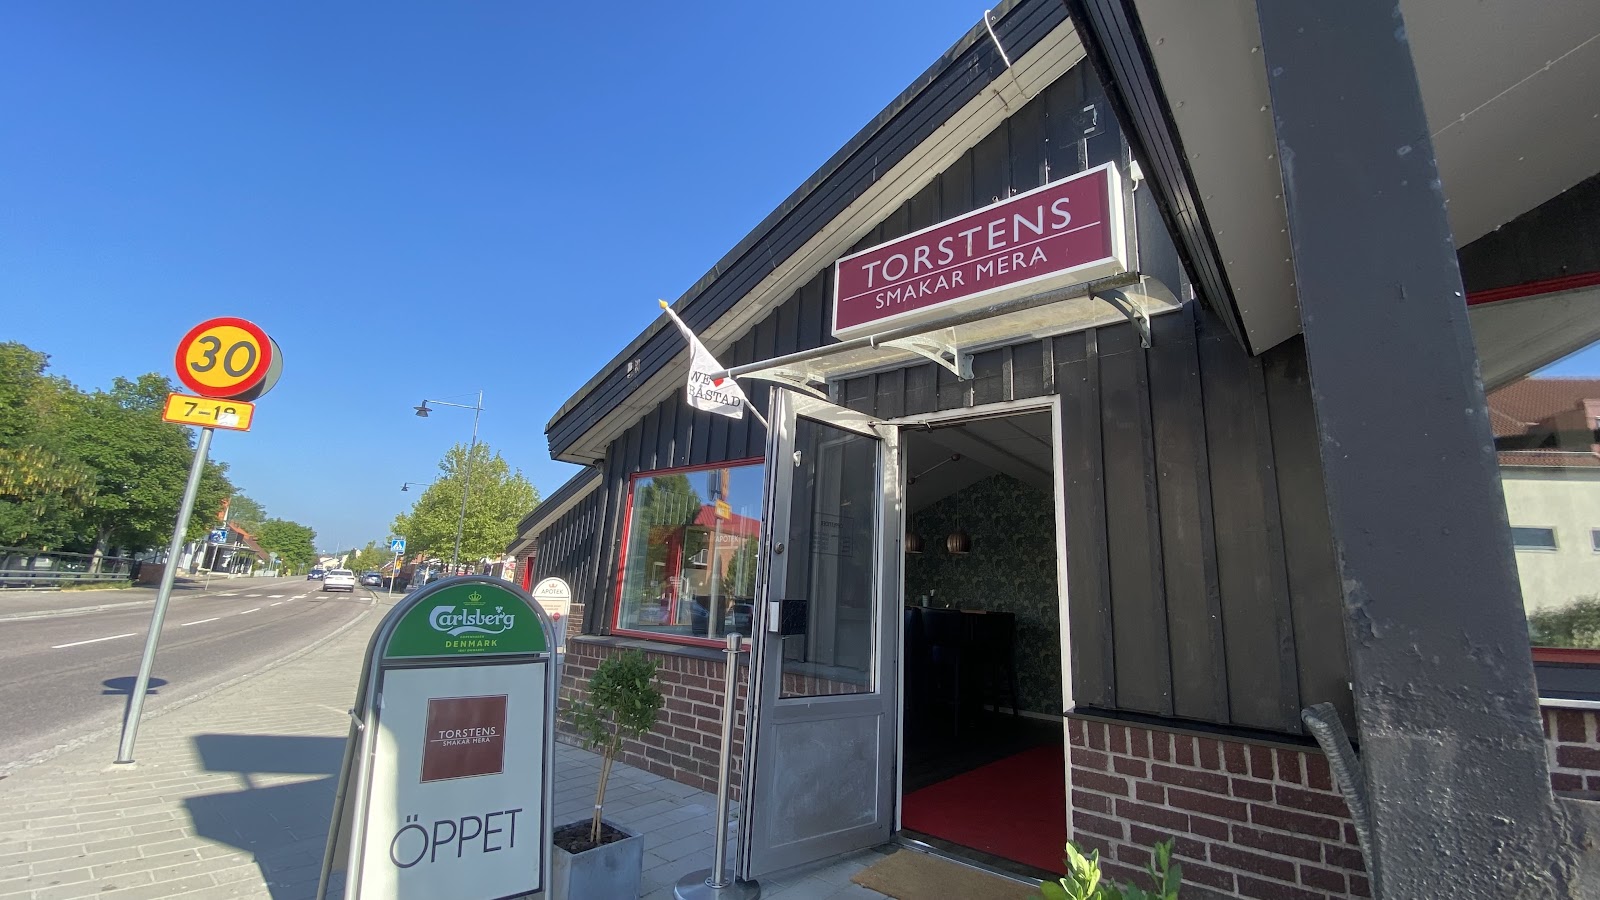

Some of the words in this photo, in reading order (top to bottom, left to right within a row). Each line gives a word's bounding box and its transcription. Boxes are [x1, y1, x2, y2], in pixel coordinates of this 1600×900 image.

[862, 197, 1072, 288] TORSTENS
[875, 271, 964, 309] SMAKAR
[976, 246, 1048, 281] MERA
[190, 335, 257, 377] 30
[688, 384, 740, 407] BÅSTAD
[716, 535, 739, 543] APOTEK
[429, 605, 515, 634] Carlsberg
[445, 640, 498, 648] DENMARK
[438, 726, 496, 740] TORSTENS
[442, 739, 470, 747] SMAKAR
[389, 808, 523, 868] ÖPPET
